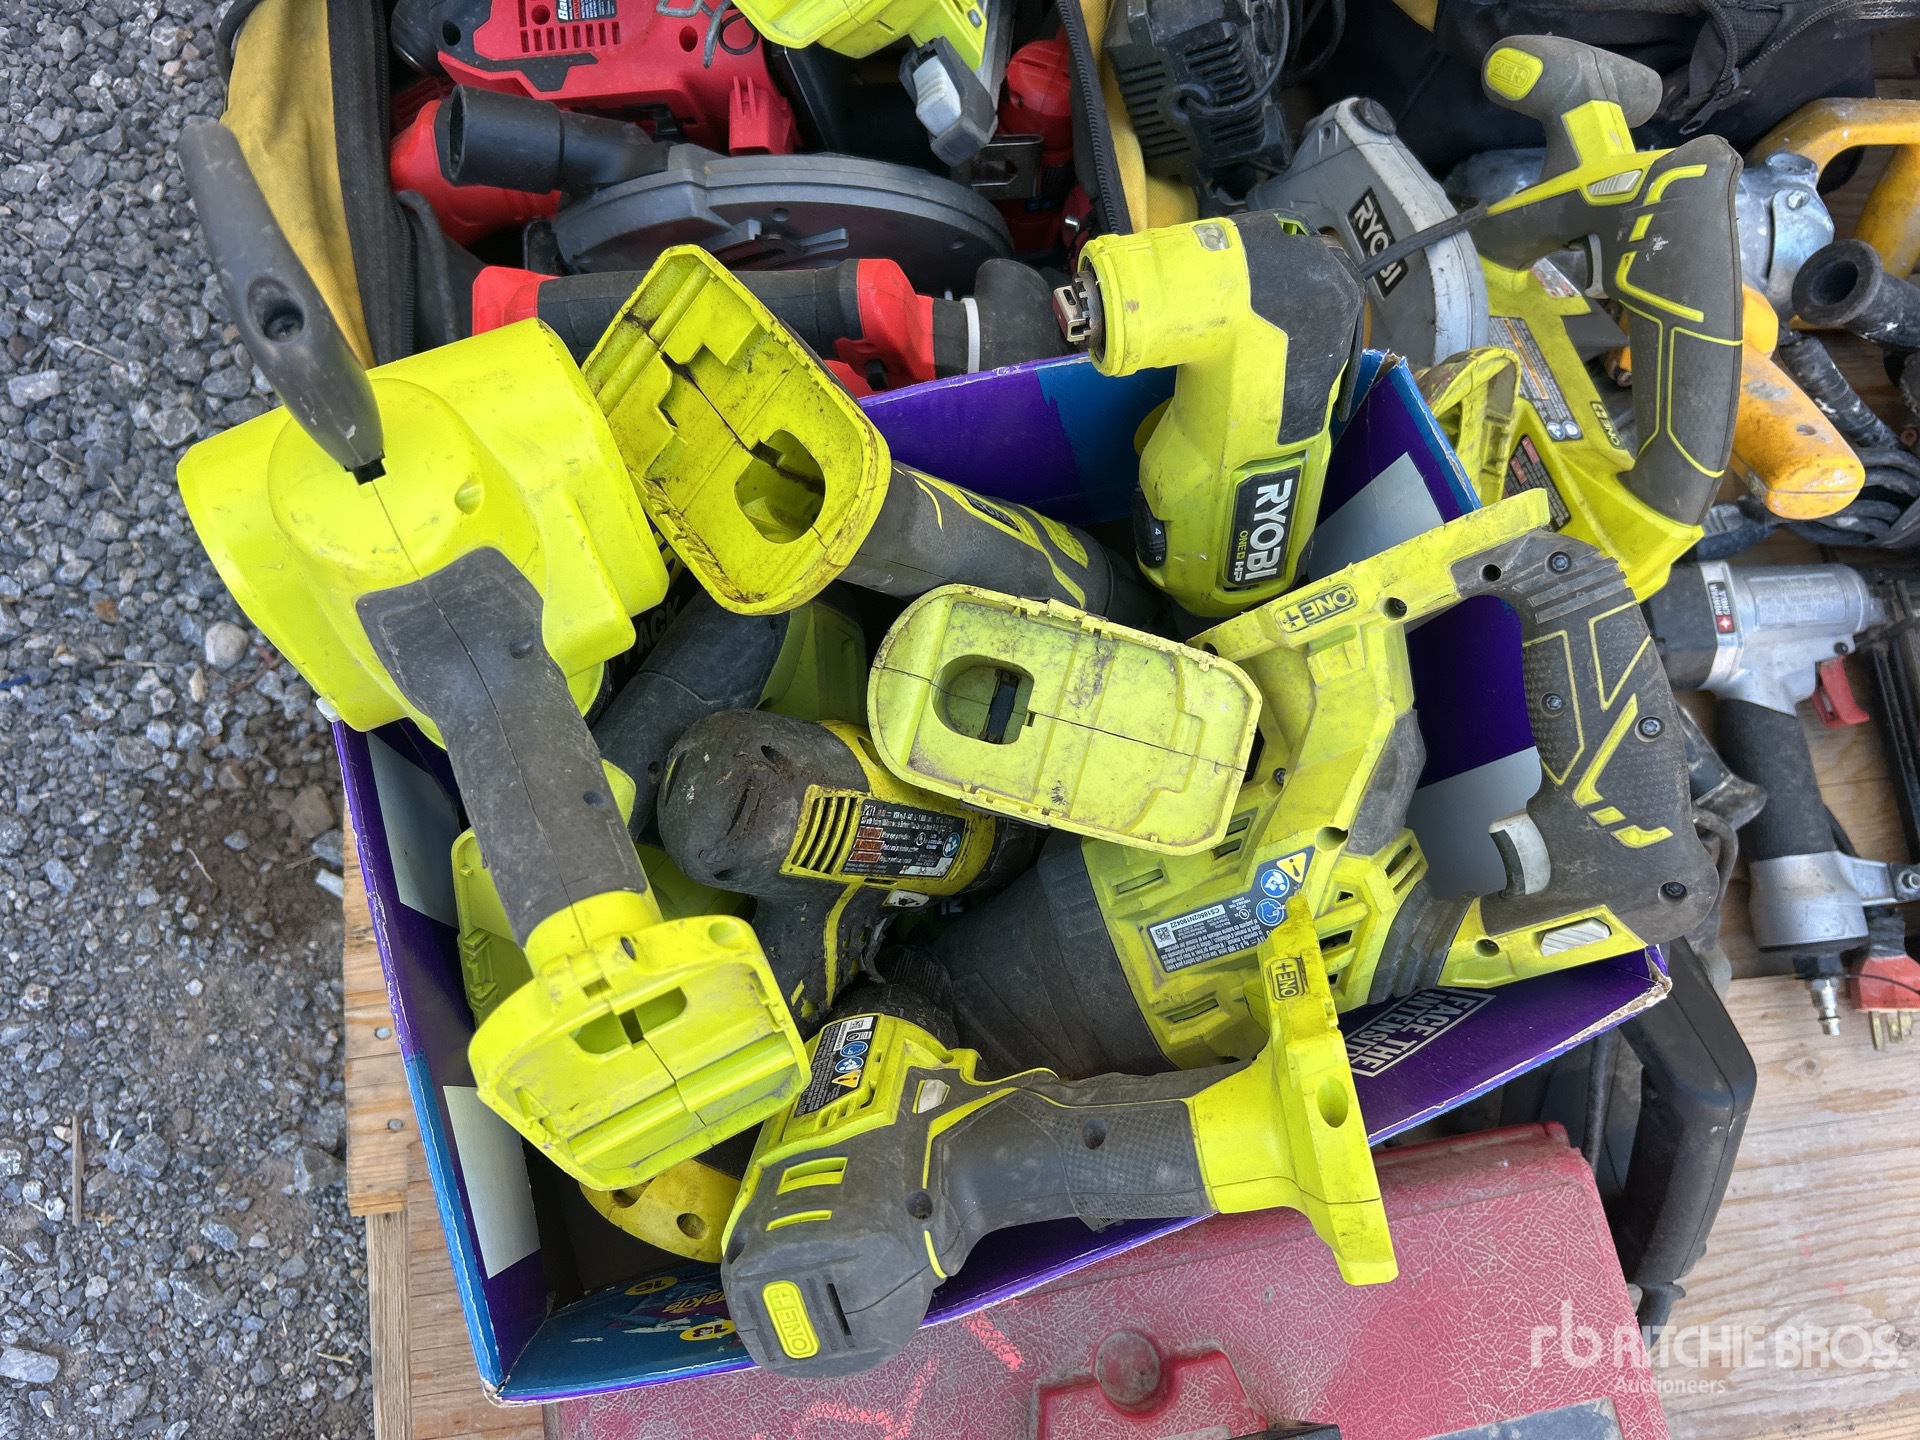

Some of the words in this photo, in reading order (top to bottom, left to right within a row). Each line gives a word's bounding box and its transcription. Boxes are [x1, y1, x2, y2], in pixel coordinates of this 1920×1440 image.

[1154, 527, 1162, 535] 4
[1245, 479, 1293, 580] RYOBI
[1233, 561, 1245, 582] HP
[1282, 589, 1351, 628] ONE+
[623, 595, 680, 664] ACK
[1276, 963, 1297, 997] ONE+
[1401, 996, 1477, 1036] FACE
[1351, 1038, 1417, 1069] THE
[773, 1289, 807, 1351] ONE+
